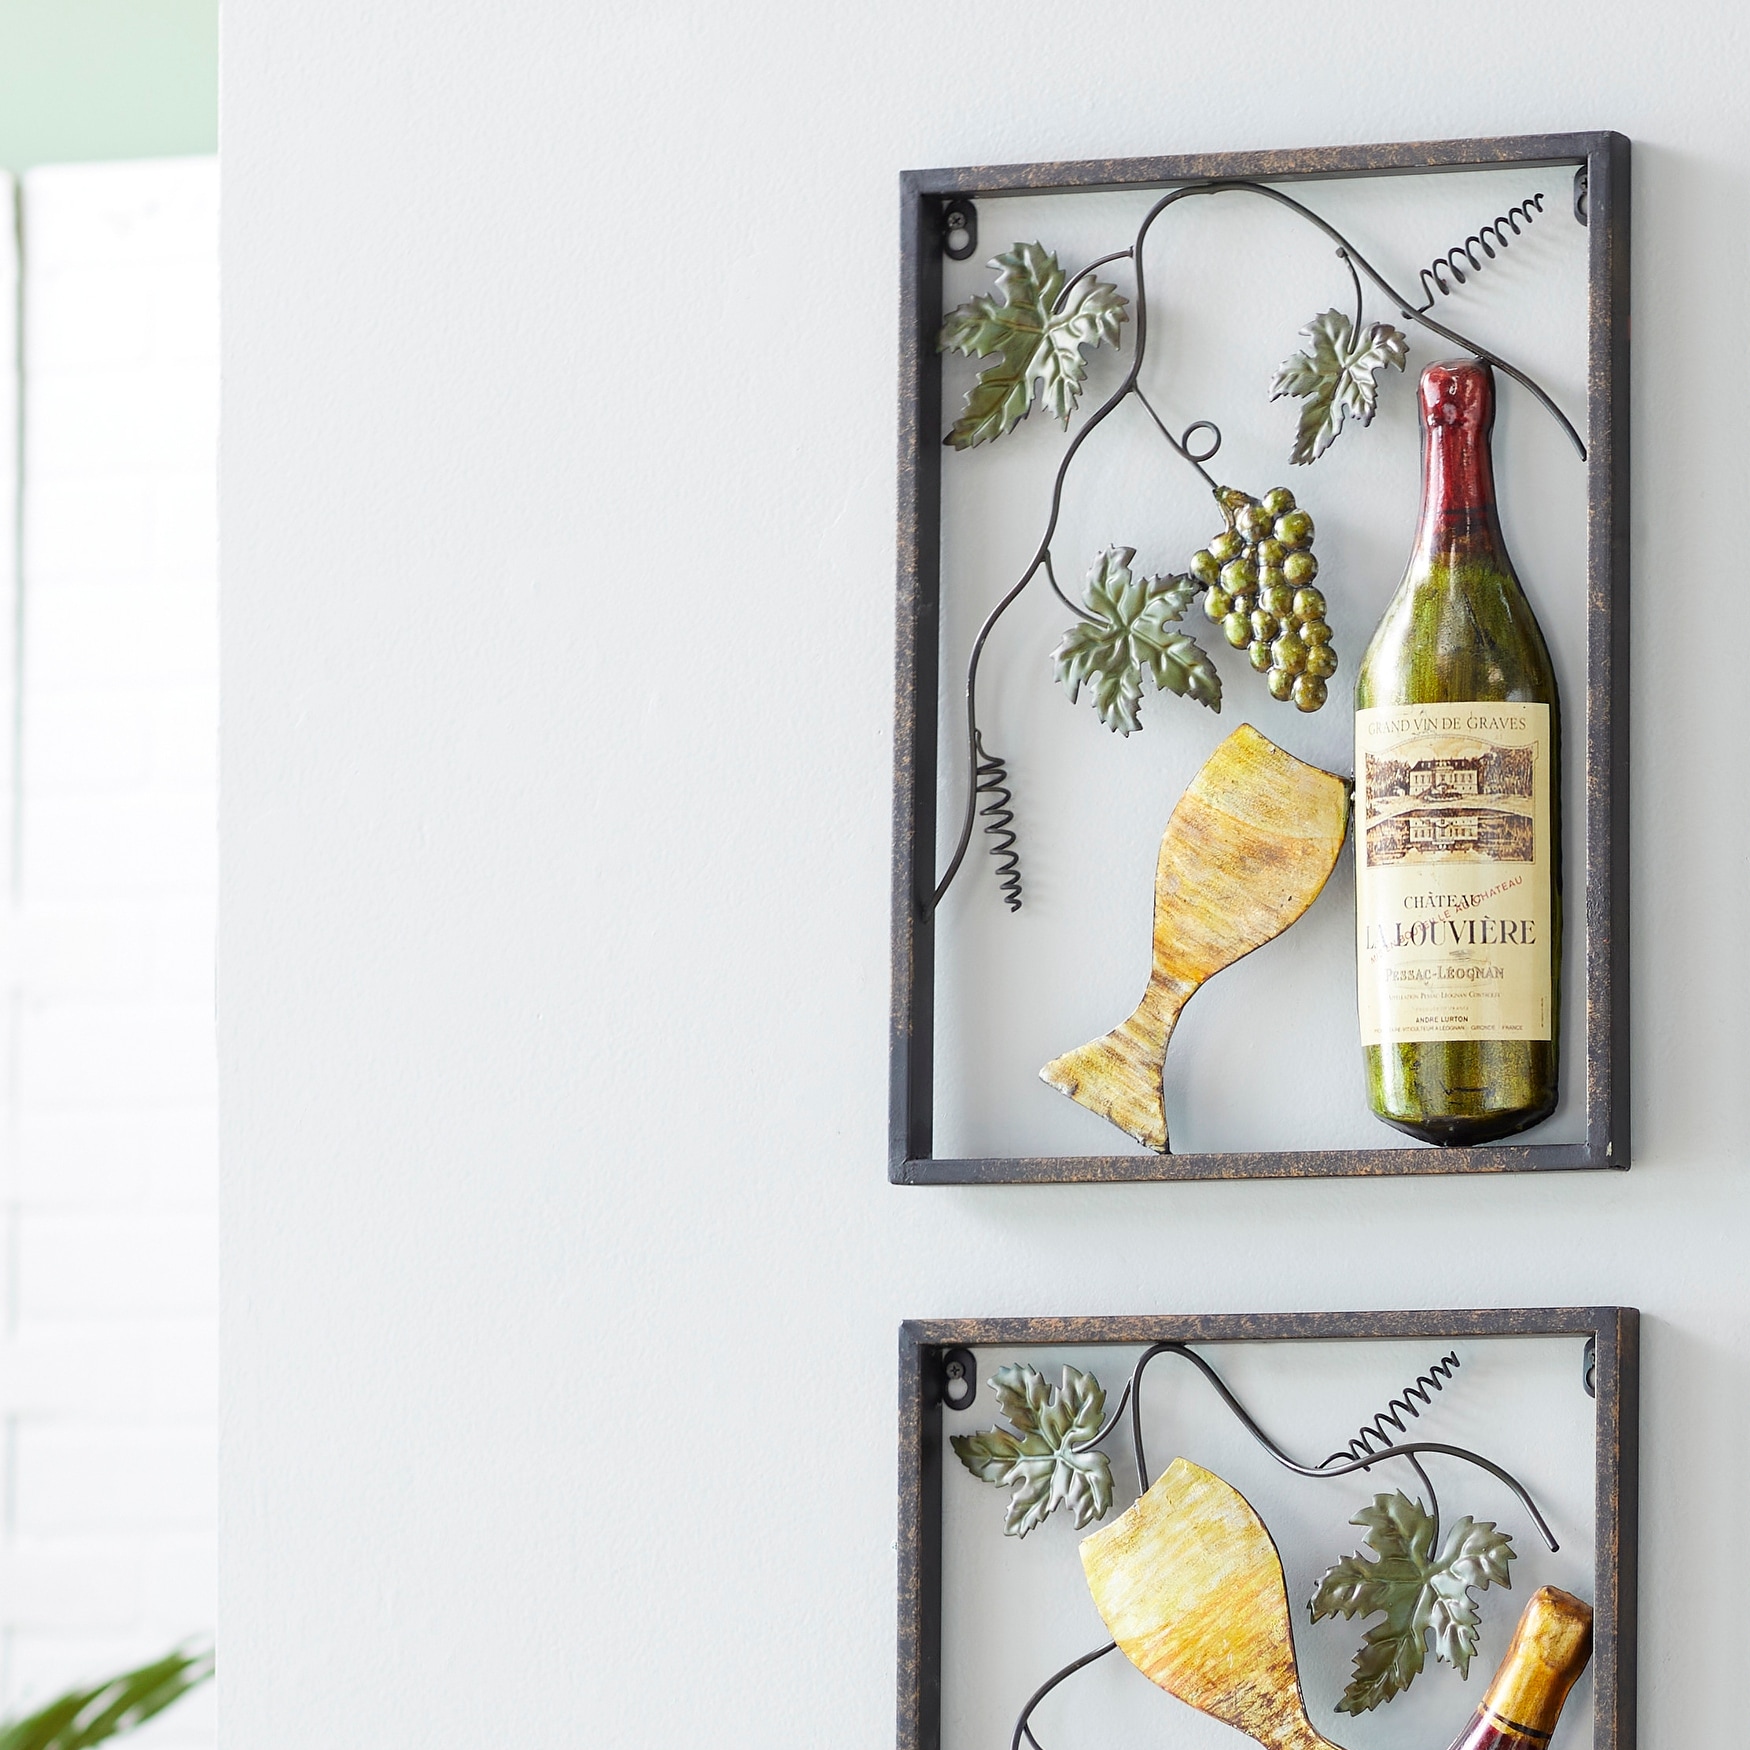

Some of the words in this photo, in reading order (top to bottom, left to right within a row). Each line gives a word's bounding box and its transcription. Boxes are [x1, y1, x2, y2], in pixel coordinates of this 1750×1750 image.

[1368, 719, 1410, 735] GRAND
[1414, 717, 1438, 731] VIN
[1442, 717, 1461, 730] DE
[1467, 716, 1526, 731] GRAVES
[1471, 875, 1523, 907] CHATEAU
[1395, 915, 1536, 947] LOUVIÈRE
[1441, 1015, 1469, 1023] LURTON
